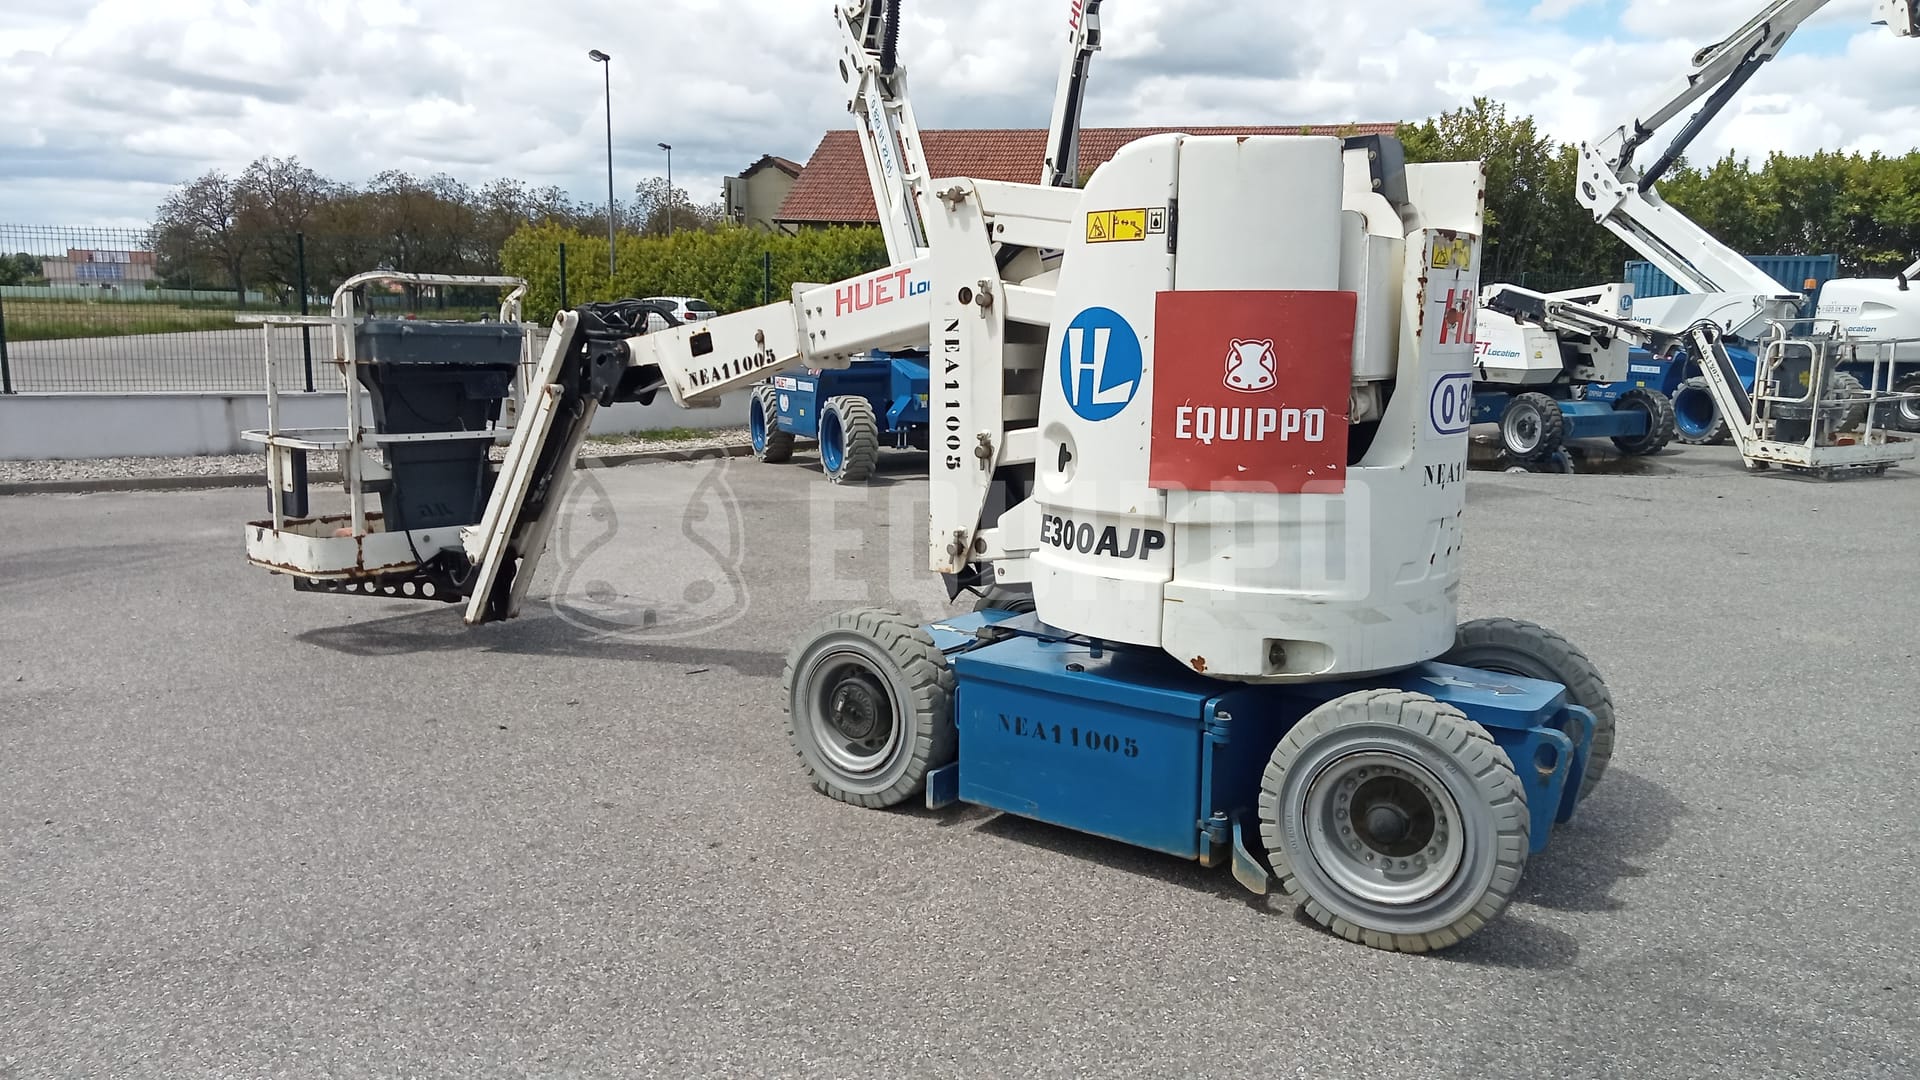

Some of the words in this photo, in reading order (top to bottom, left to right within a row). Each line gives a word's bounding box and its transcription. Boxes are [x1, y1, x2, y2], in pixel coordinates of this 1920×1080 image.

[835, 268, 911, 317] HUET
[909, 280, 930, 297] Lo
[1845, 325, 1877, 333] ocation
[688, 348, 776, 388] NEA11005
[1068, 328, 1134, 406] HL
[1488, 349, 1520, 358] Location
[945, 318, 961, 470] NEA11005
[1442, 384, 1455, 425] 0
[1175, 406, 1325, 445] EQUIPPO
[1040, 513, 1166, 560] E300AJP
[998, 713, 1139, 758] NEA11005
